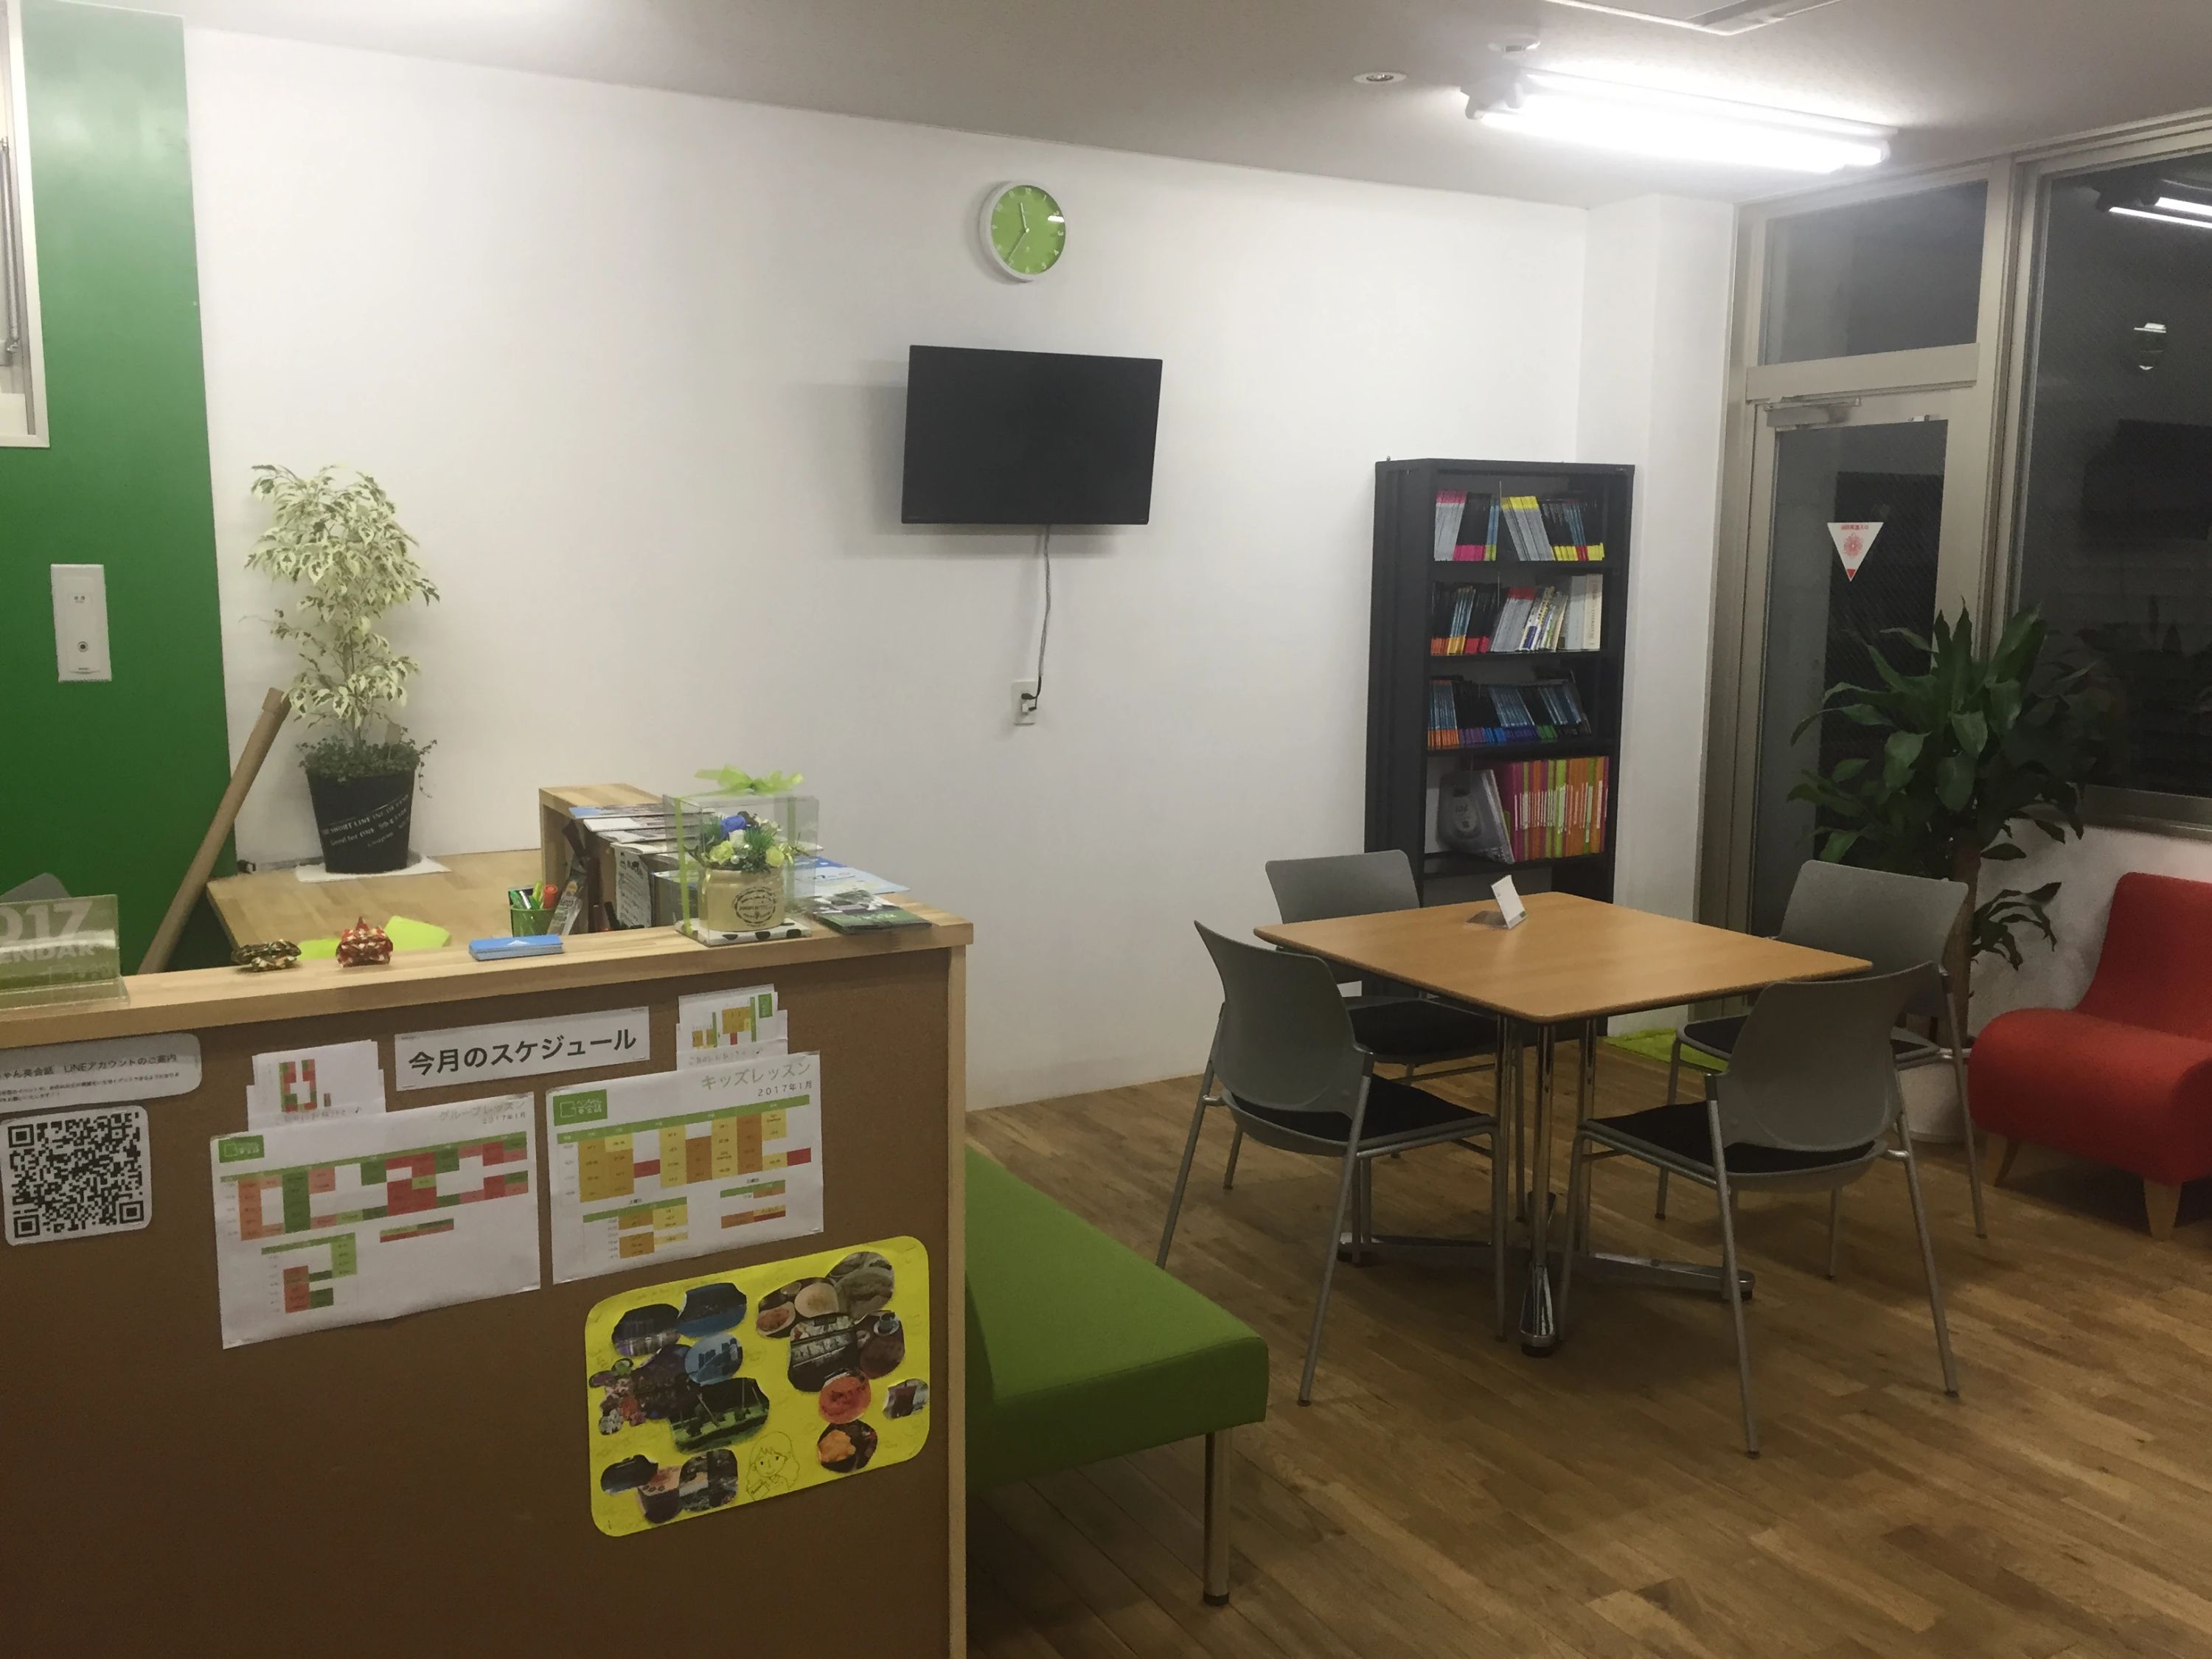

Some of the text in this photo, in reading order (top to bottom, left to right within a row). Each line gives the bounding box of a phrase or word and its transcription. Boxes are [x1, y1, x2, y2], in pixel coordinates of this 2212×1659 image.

[408, 1029, 637, 1076] 今月のスケジュール
[702, 1062, 811, 1091] キッズレッスン
[758, 1080, 813, 1096] 2017年1月
